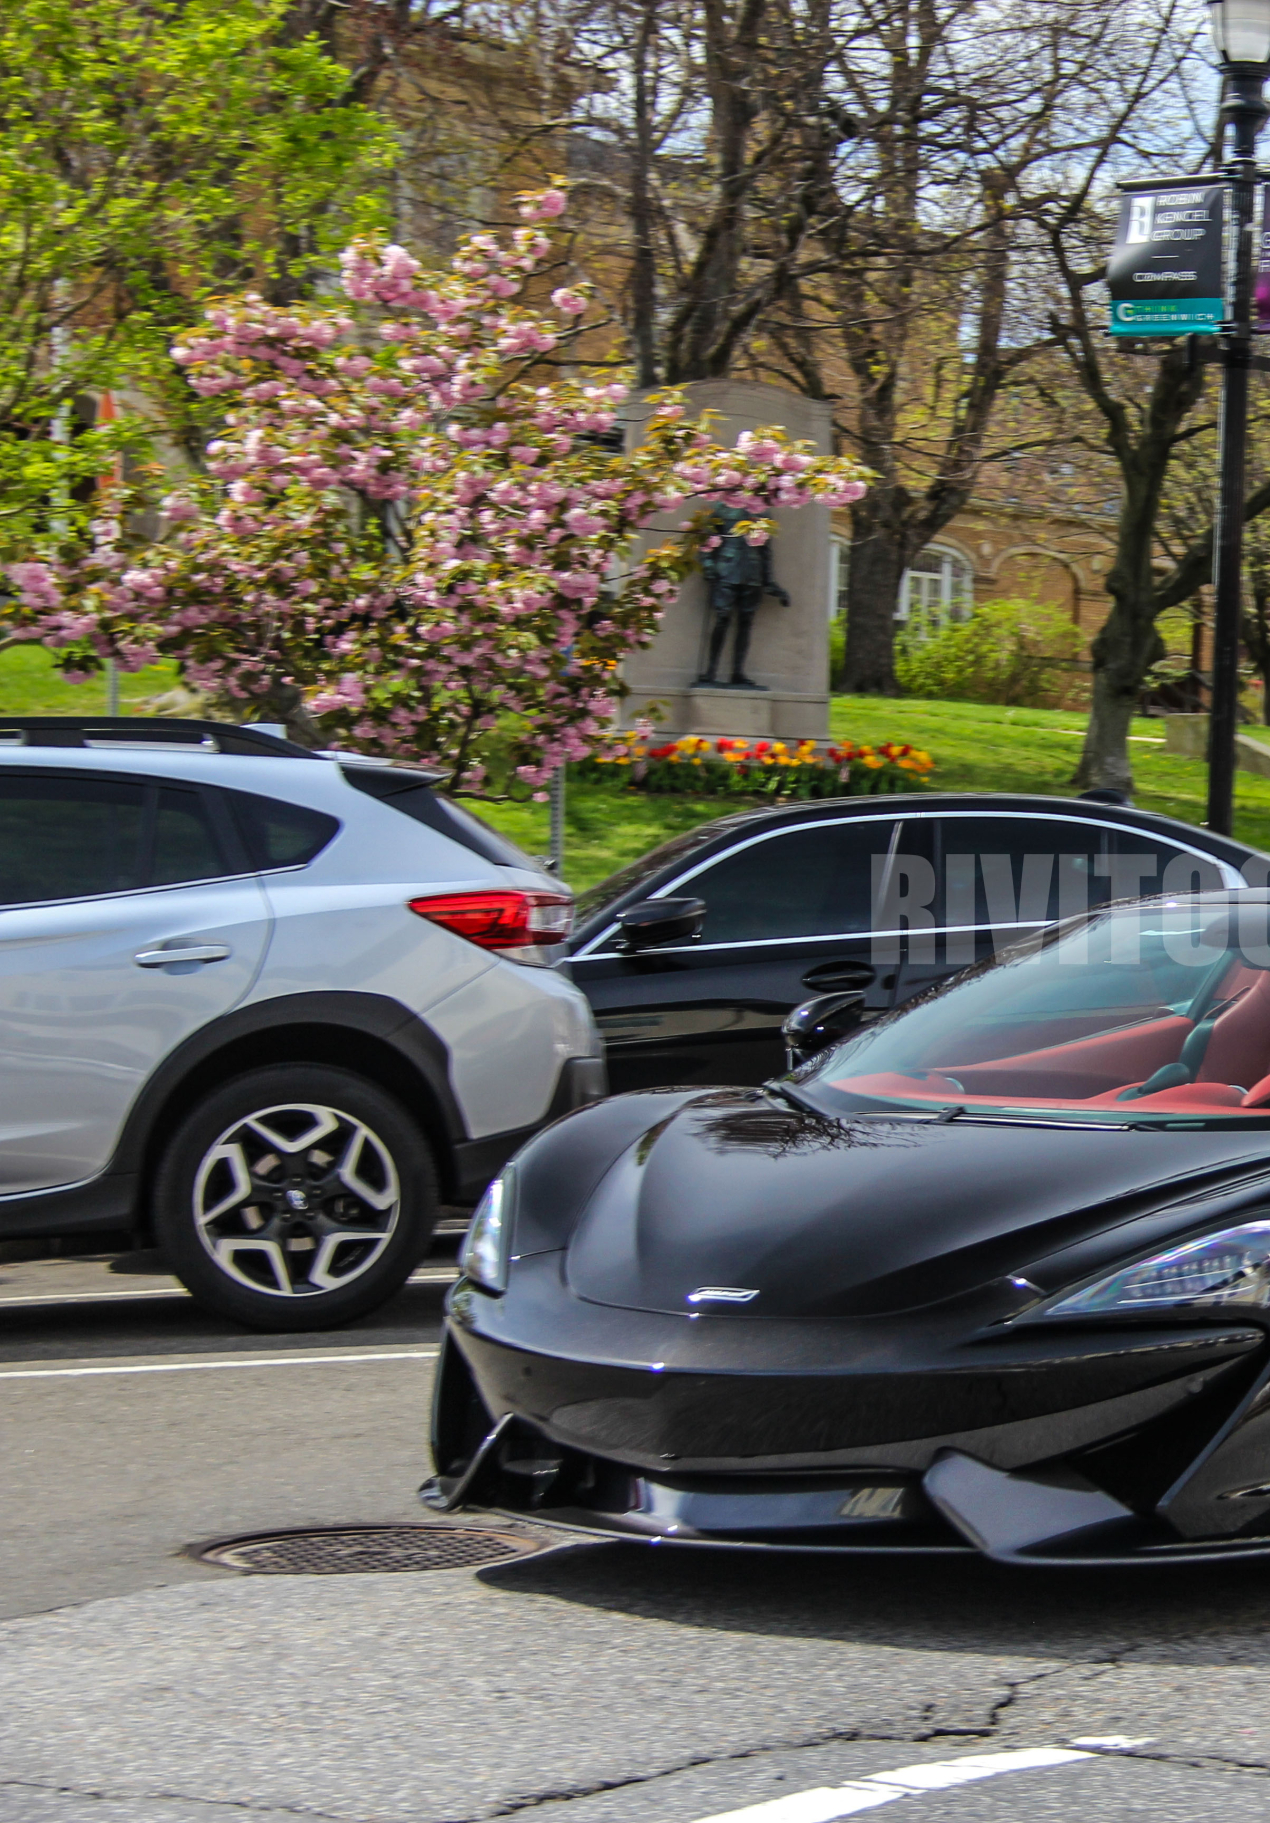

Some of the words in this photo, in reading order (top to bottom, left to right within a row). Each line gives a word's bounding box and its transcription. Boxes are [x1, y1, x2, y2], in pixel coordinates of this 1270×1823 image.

[1151, 228, 1206, 241] GROUP
[1132, 271, 1198, 282] COMPASS
[1134, 313, 1215, 322] GREENWICH
